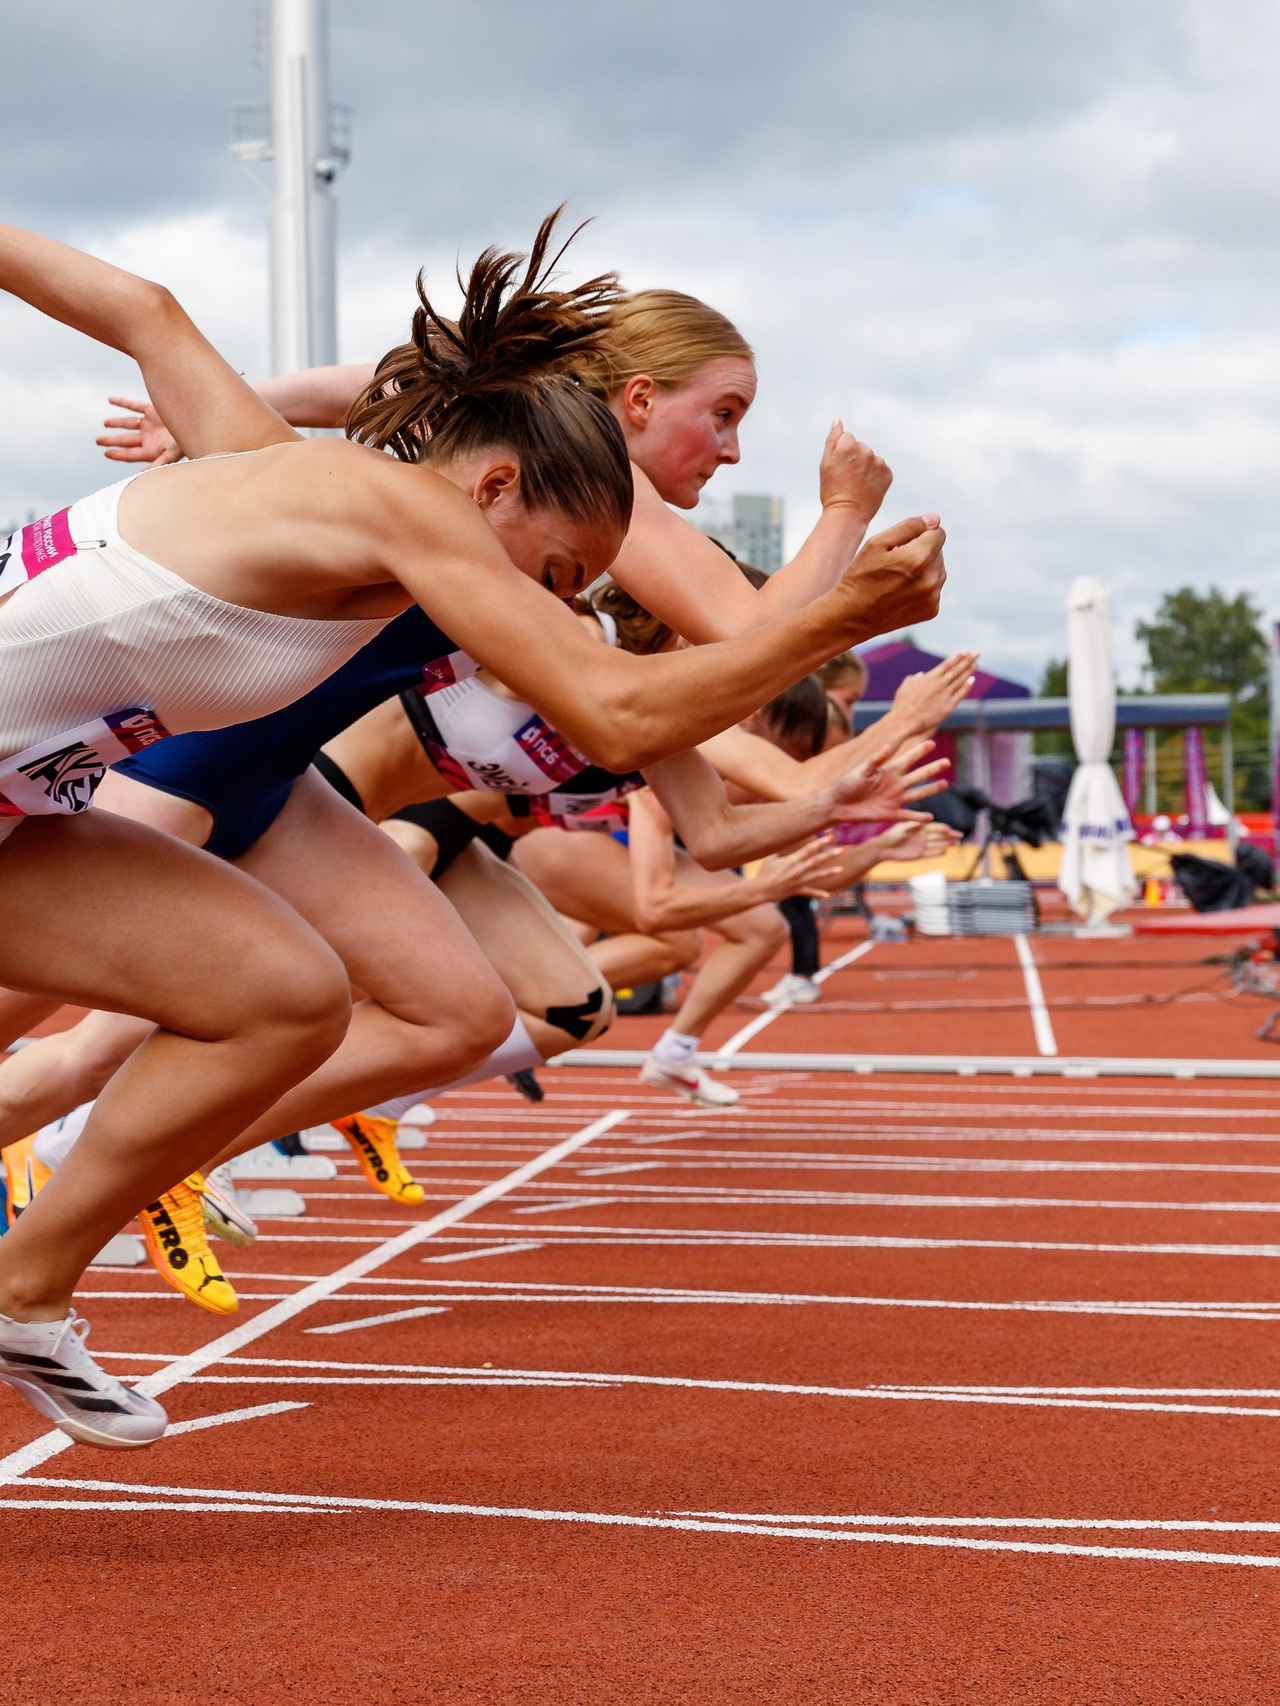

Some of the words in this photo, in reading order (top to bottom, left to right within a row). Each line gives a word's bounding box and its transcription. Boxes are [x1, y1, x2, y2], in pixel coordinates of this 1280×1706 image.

[43, 529, 59, 558] РОССИИ
[533, 738, 559, 765] ПСБ
[344, 1117, 389, 1182] NITRO
[146, 1200, 189, 1269] ITRO
